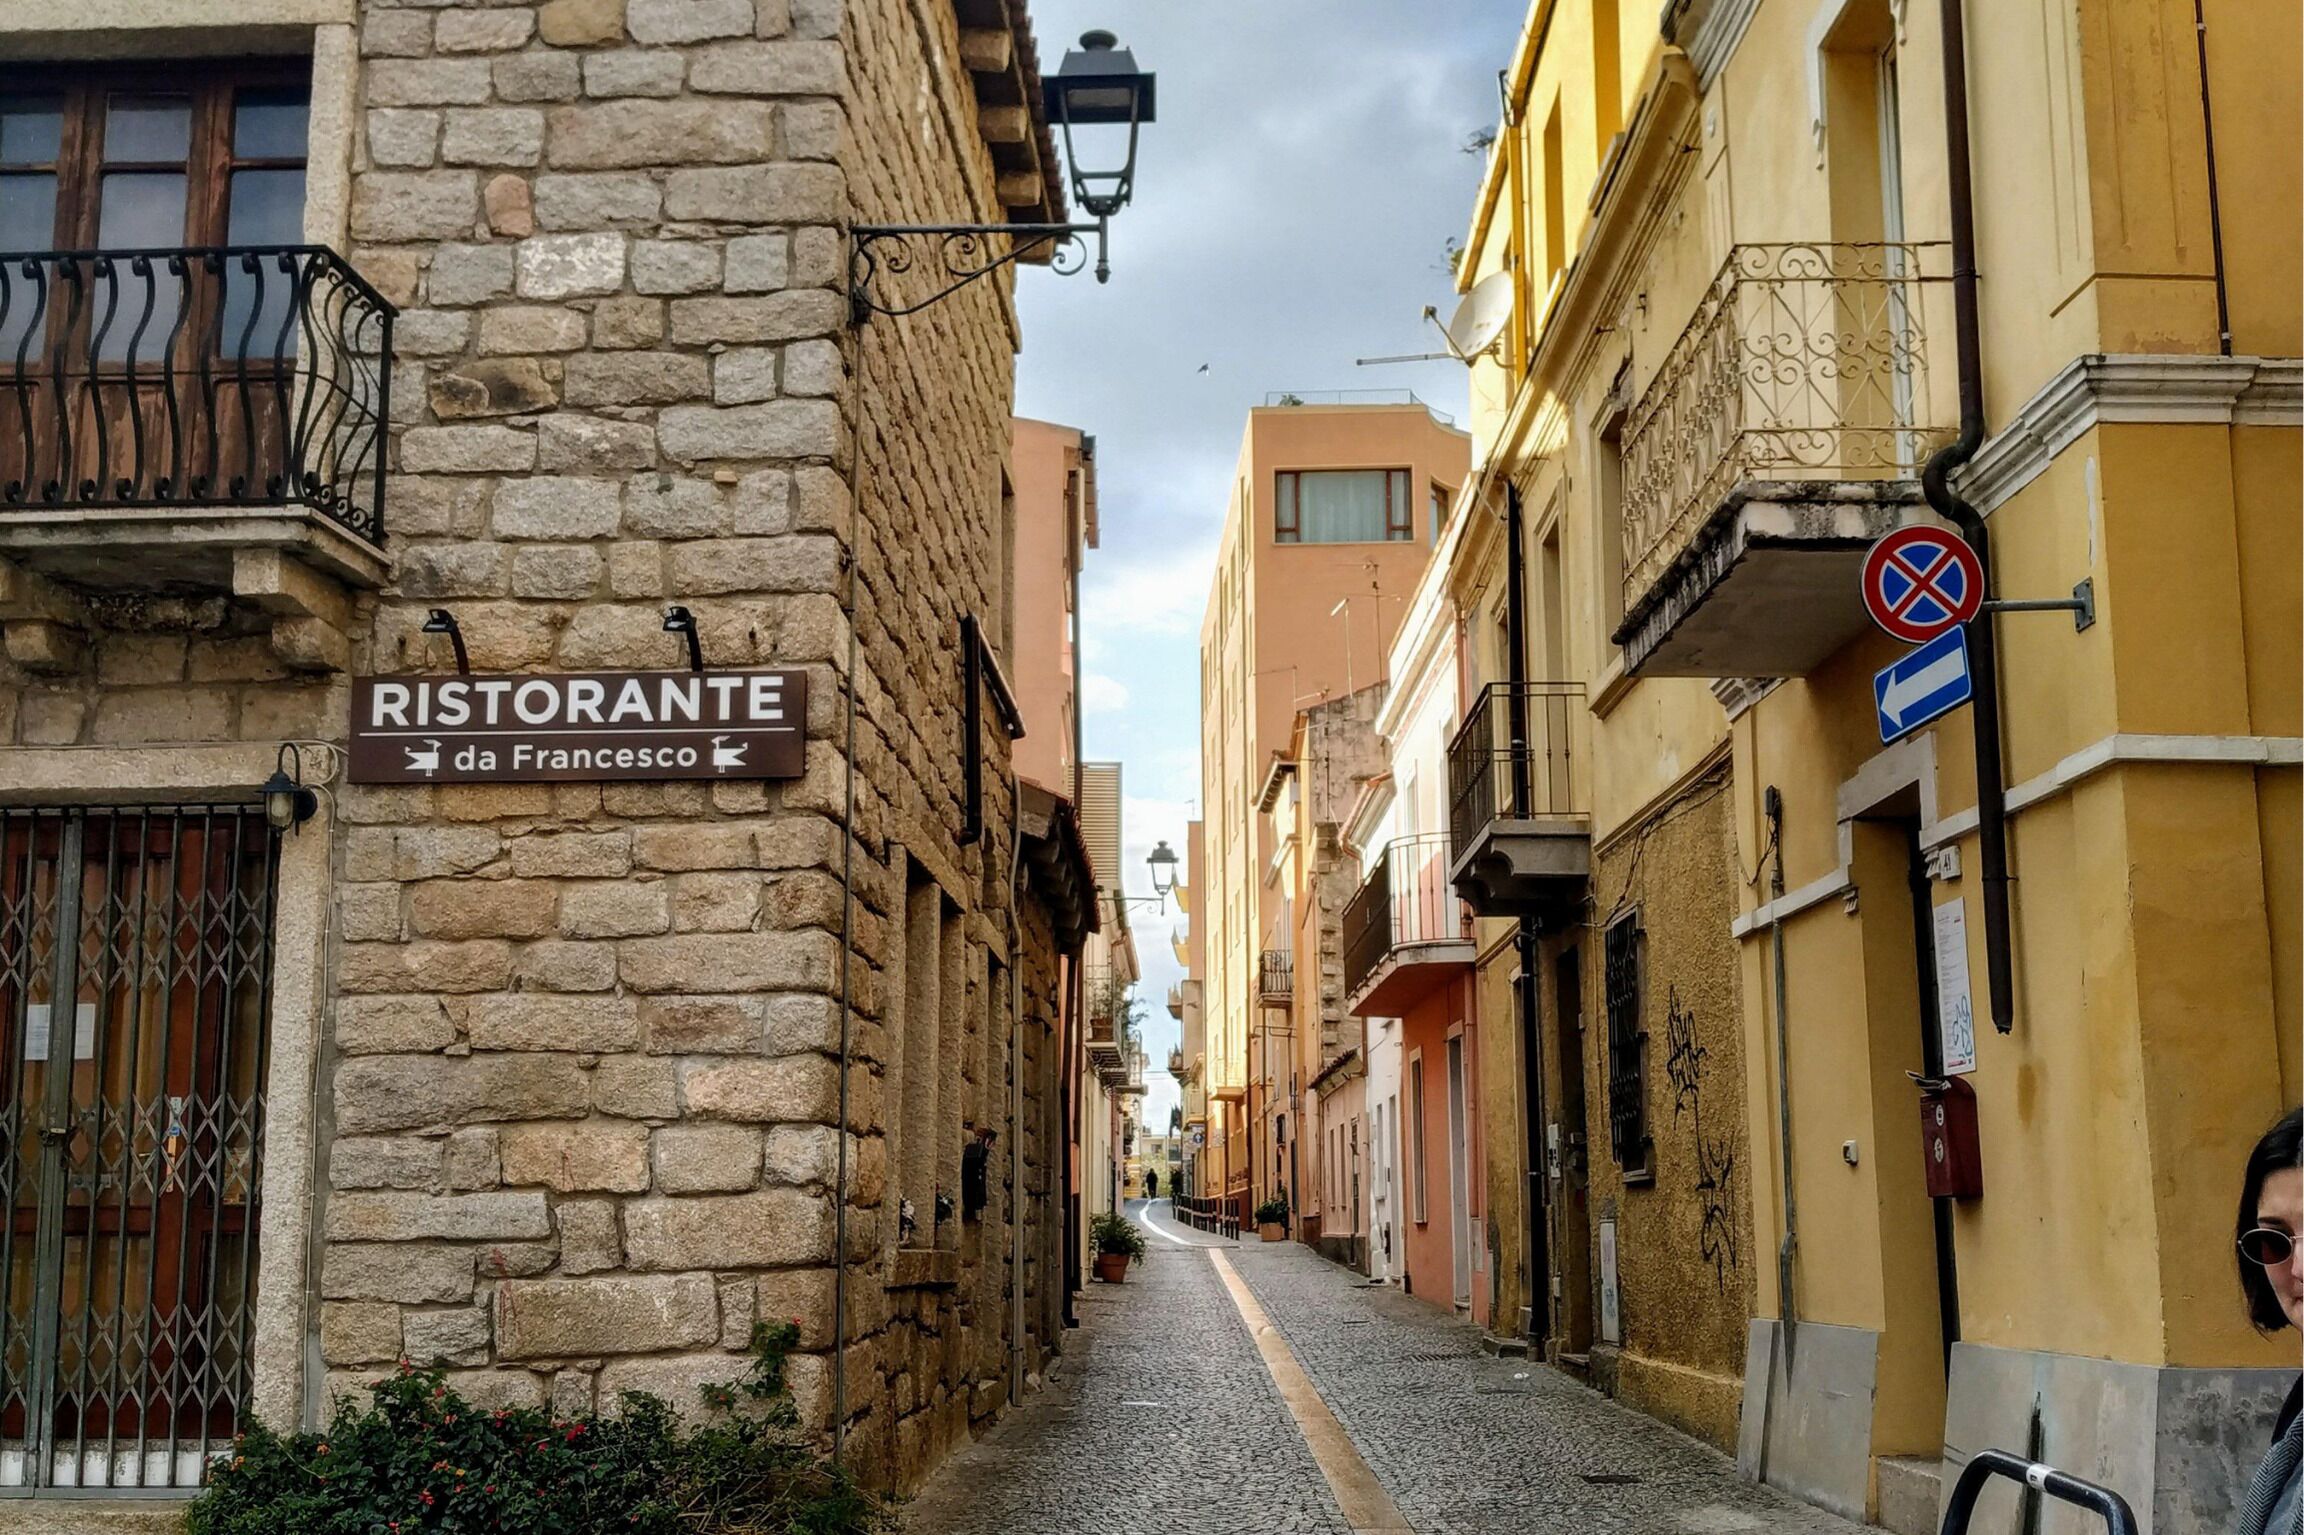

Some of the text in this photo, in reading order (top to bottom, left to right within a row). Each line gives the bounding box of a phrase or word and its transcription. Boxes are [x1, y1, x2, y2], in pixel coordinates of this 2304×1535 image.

[371, 676, 785, 727] RISTORANTE
[454, 744, 698, 772] da Francesco
